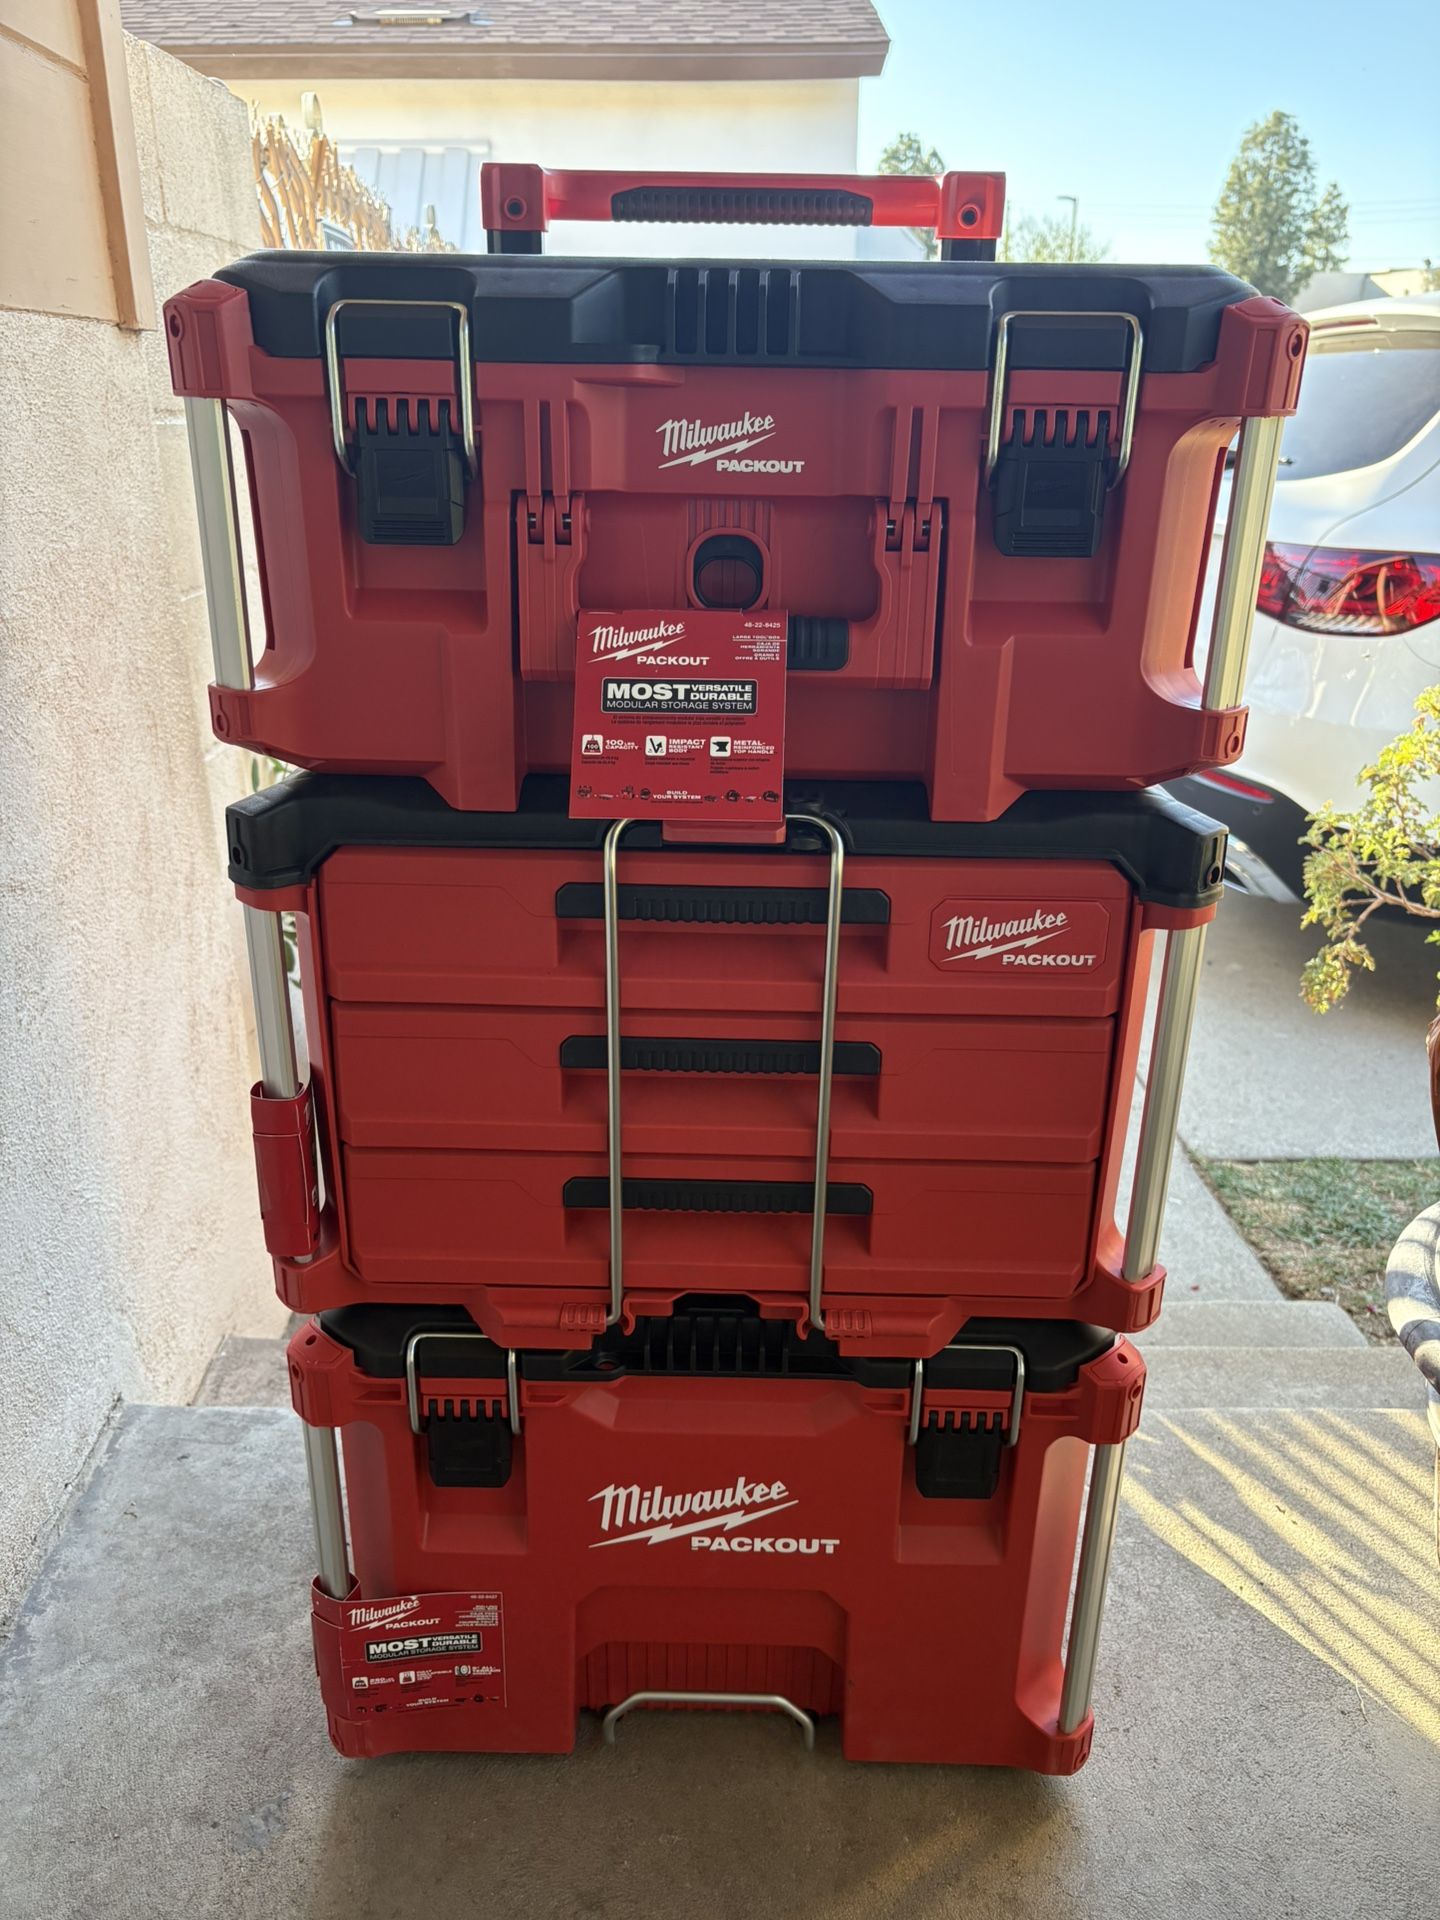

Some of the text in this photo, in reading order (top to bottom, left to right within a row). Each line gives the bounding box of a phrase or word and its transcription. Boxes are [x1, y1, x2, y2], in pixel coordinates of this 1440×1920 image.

[656, 411, 775, 457] Milwaukee
[716, 459, 805, 473] PACKOUT
[587, 620, 686, 654] Milwaukee
[636, 655, 711, 666] PACKOUT
[607, 683, 690, 700] MOST
[691, 684, 753, 692] VERSATILE
[690, 692, 753, 701] DURABLE
[606, 700, 753, 710] MODULAR STORAGE SYSTEM
[668, 738, 706, 746] IMPACT
[940, 909, 1069, 951] Milwaukee
[1002, 954, 1097, 966] PACKOUT
[587, 1476, 790, 1532] Milwaukee
[691, 1536, 841, 1554] PACKOUT
[346, 1599, 420, 1626] Milwaukee
[385, 1617, 441, 1630] PACKOUT
[432, 1633, 478, 1641] VERSATILE
[432, 1638, 478, 1647] DURABLE
[368, 1637, 431, 1655] MOST
[369, 1650, 410, 1660] MODULAR
[410, 1646, 448, 1655] STORAGE
